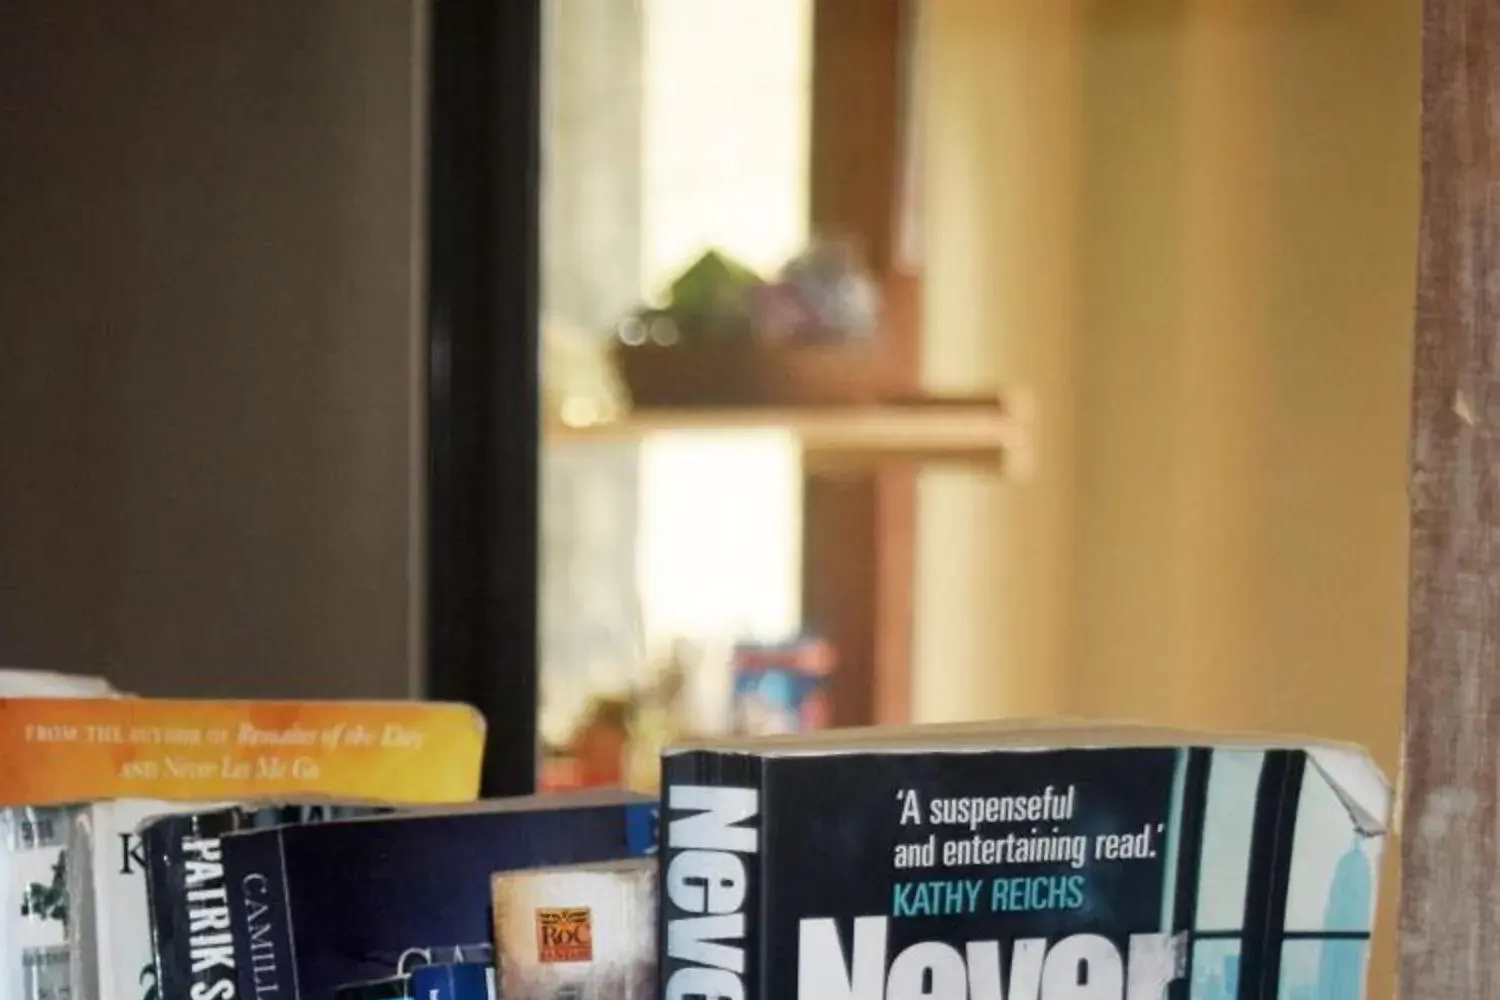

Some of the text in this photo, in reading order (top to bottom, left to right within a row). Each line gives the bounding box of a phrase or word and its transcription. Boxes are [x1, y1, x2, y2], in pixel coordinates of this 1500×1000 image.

[25, 724, 78, 744] FROM
[86, 724, 124, 744] THE
[237, 721, 316, 748] Remains
[119, 756, 321, 779] AND Never Let Me Go
[929, 785, 1076, 831] suspenseful
[894, 835, 936, 868] and
[943, 828, 1087, 870] entertaining
[181, 835, 235, 974] PATRIK
[892, 875, 1084, 918] KATHY REICHS
